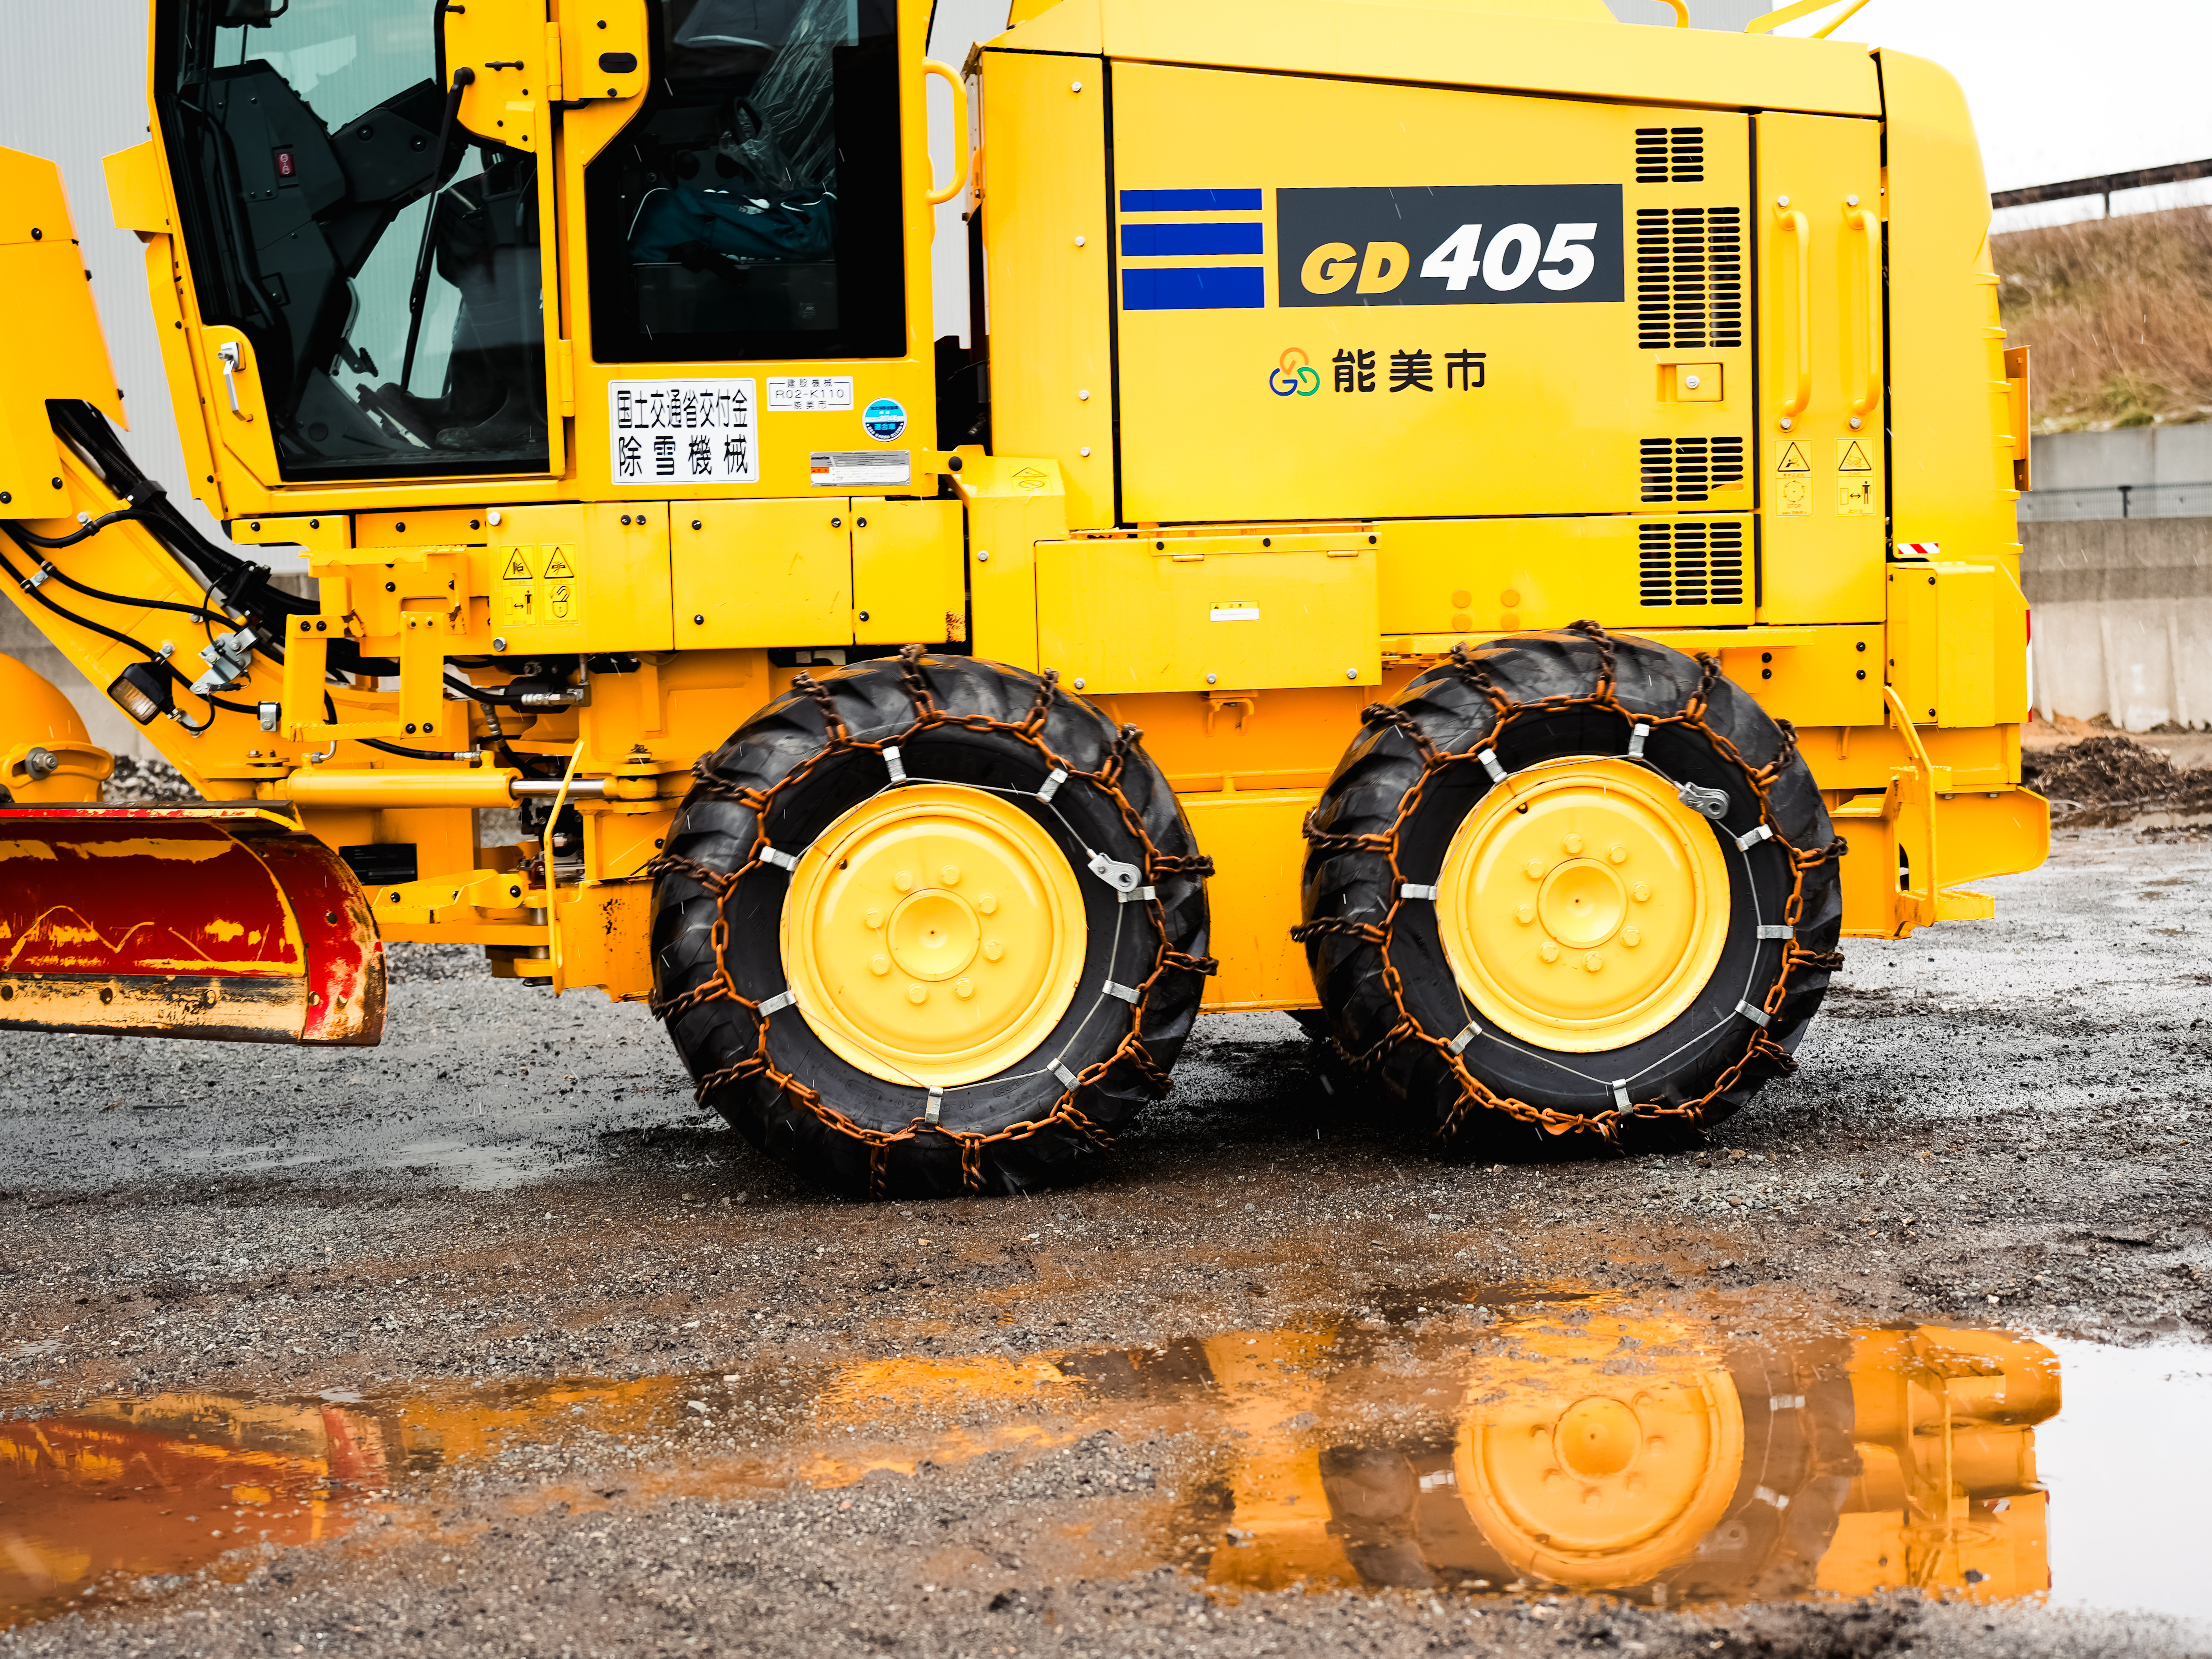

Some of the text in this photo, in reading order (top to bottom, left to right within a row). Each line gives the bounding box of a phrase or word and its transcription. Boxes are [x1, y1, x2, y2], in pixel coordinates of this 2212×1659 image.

[1301, 223, 1598, 294] GD 405
[1332, 348, 1487, 393] 能美市
[617, 389, 748, 429] 国土交通省交付金
[776, 389, 844, 399] R02-K110
[794, 401, 827, 409] 能美市
[618, 434, 748, 477] 除雪機械
